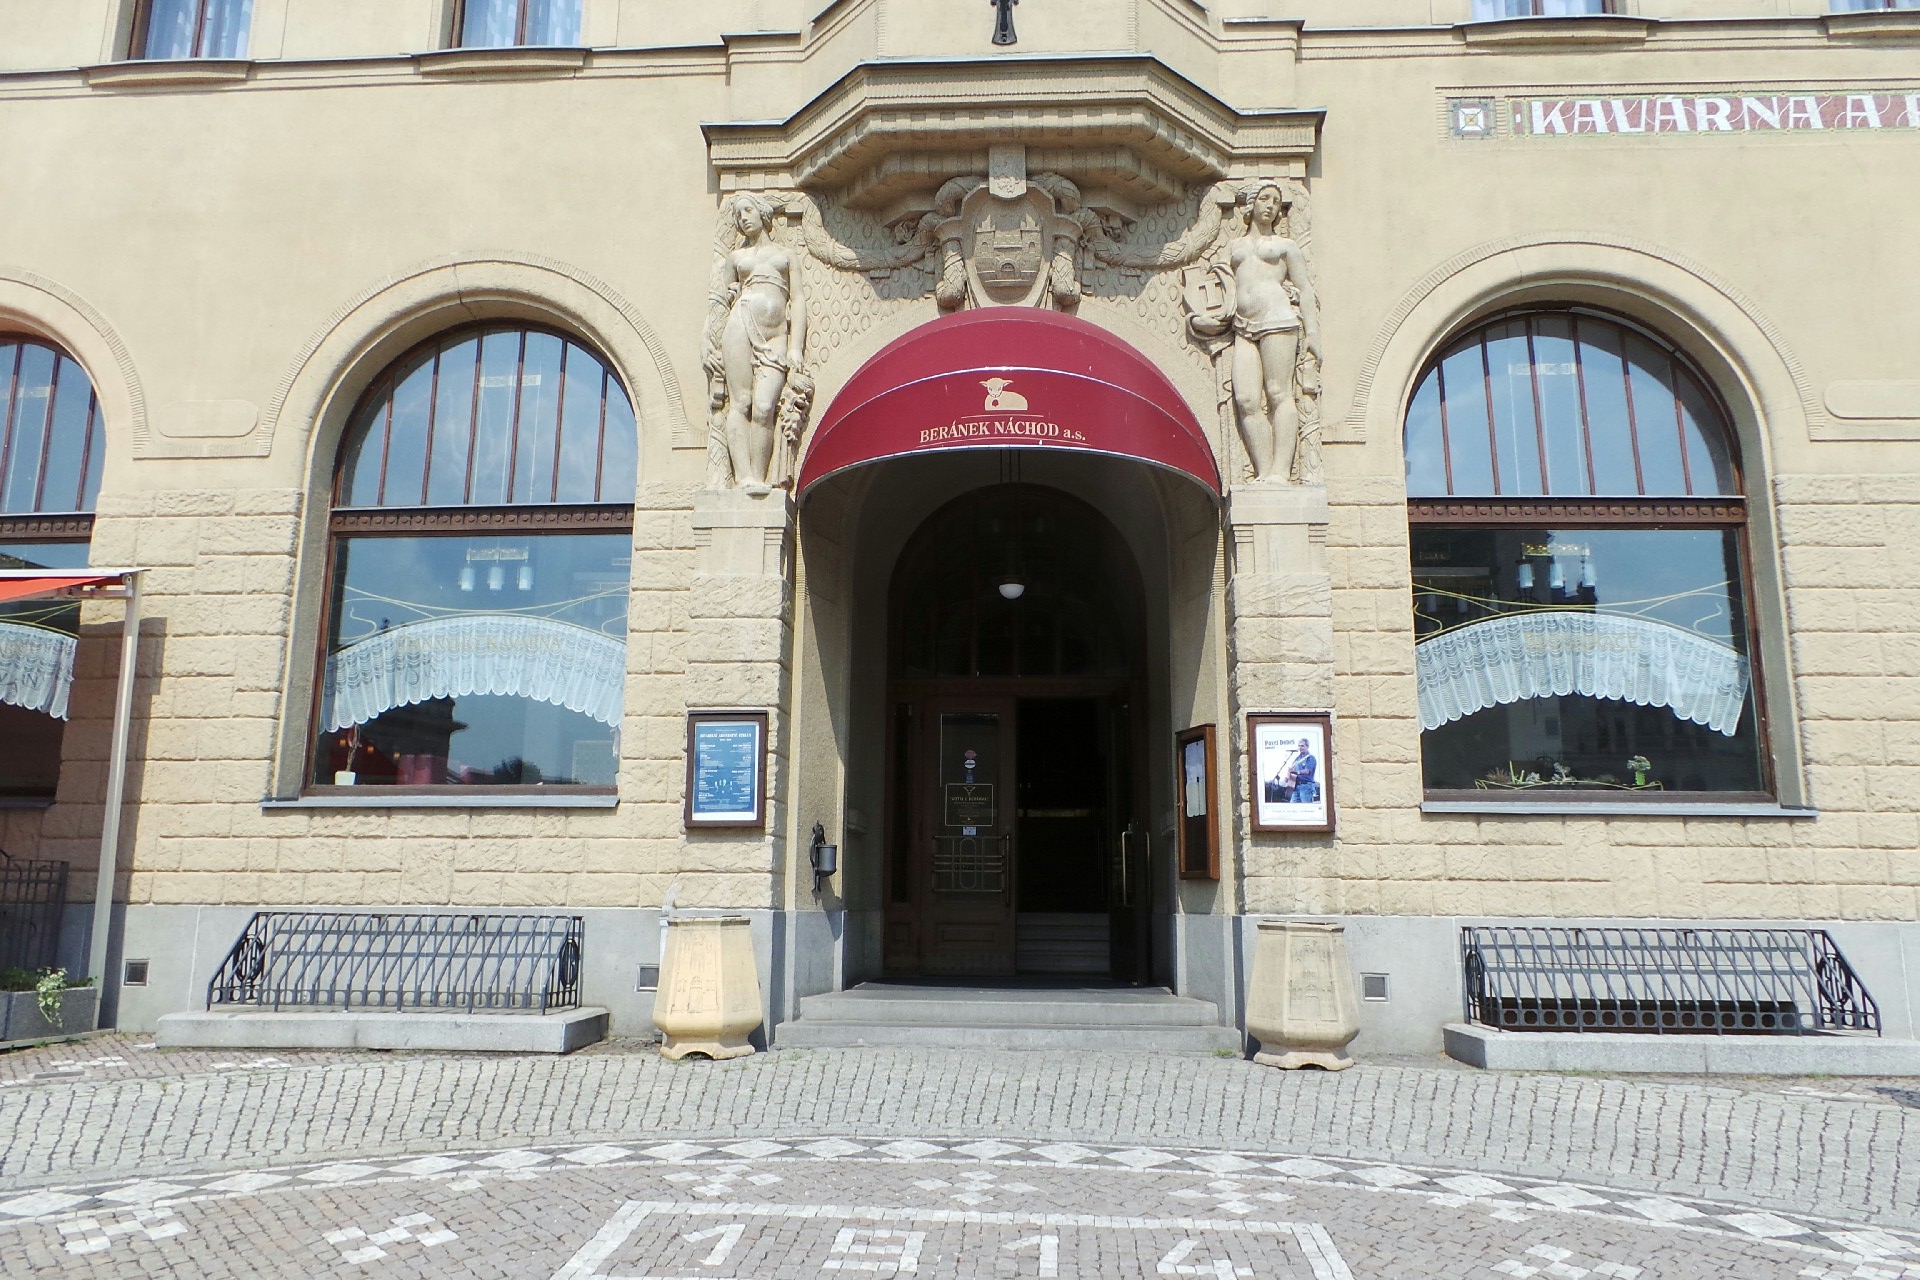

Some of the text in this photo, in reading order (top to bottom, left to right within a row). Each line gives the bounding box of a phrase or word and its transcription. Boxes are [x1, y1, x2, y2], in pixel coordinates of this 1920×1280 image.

[1531, 94, 1824, 135] KAVÁRNA
[1846, 95, 1883, 128] A
[919, 416, 1086, 444] BERÁNEK NÁCHOD a.s.
